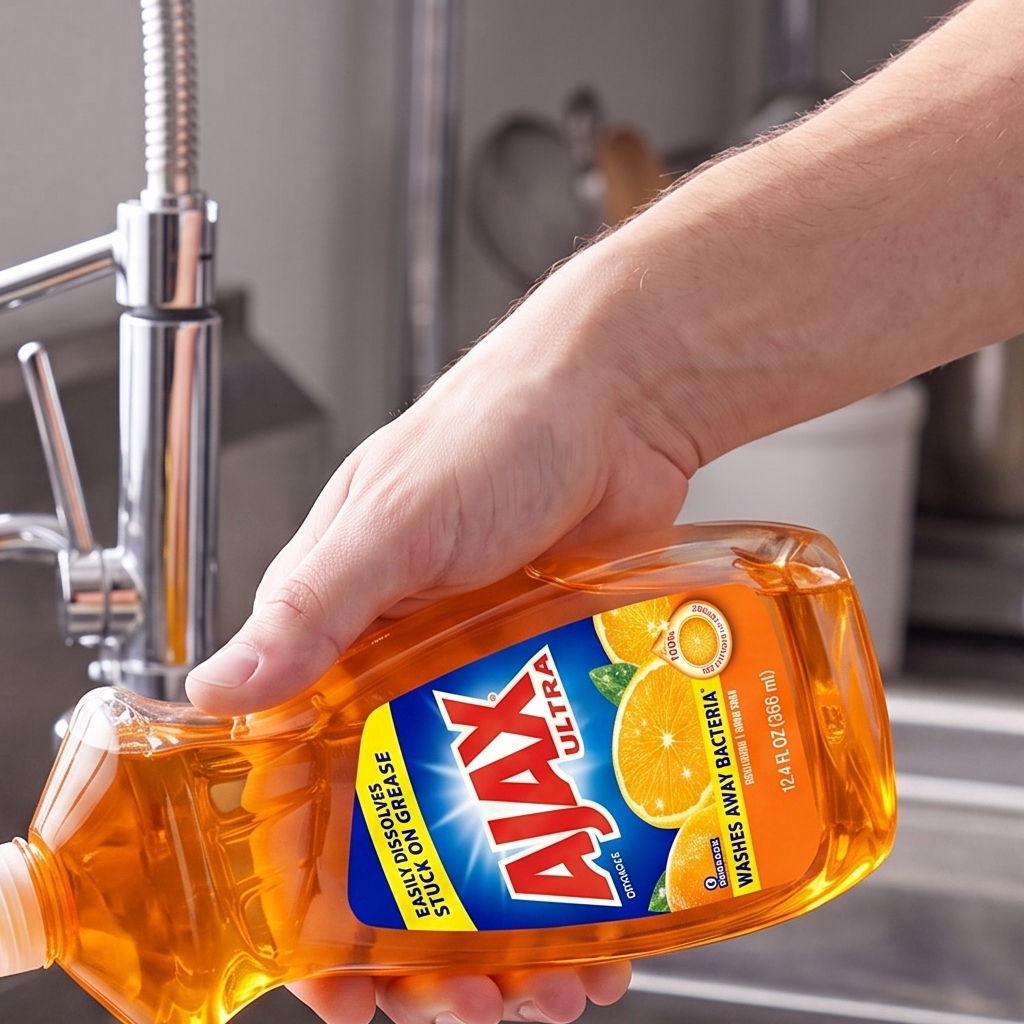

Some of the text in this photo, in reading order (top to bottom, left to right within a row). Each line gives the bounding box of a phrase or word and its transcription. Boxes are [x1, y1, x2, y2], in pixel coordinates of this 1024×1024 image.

[533, 653, 580, 756] ULTRA
[702, 690, 732, 769] BACTERIA
[770, 728, 788, 749] OZ
[441, 671, 615, 901] AJAX
[718, 773, 741, 817] AWAY
[775, 748, 791, 766] FL
[368, 783, 430, 918] EASILY DISSOLVES
[375, 751, 450, 917] STUCK ON GREASE
[728, 821, 753, 889] WASHES
